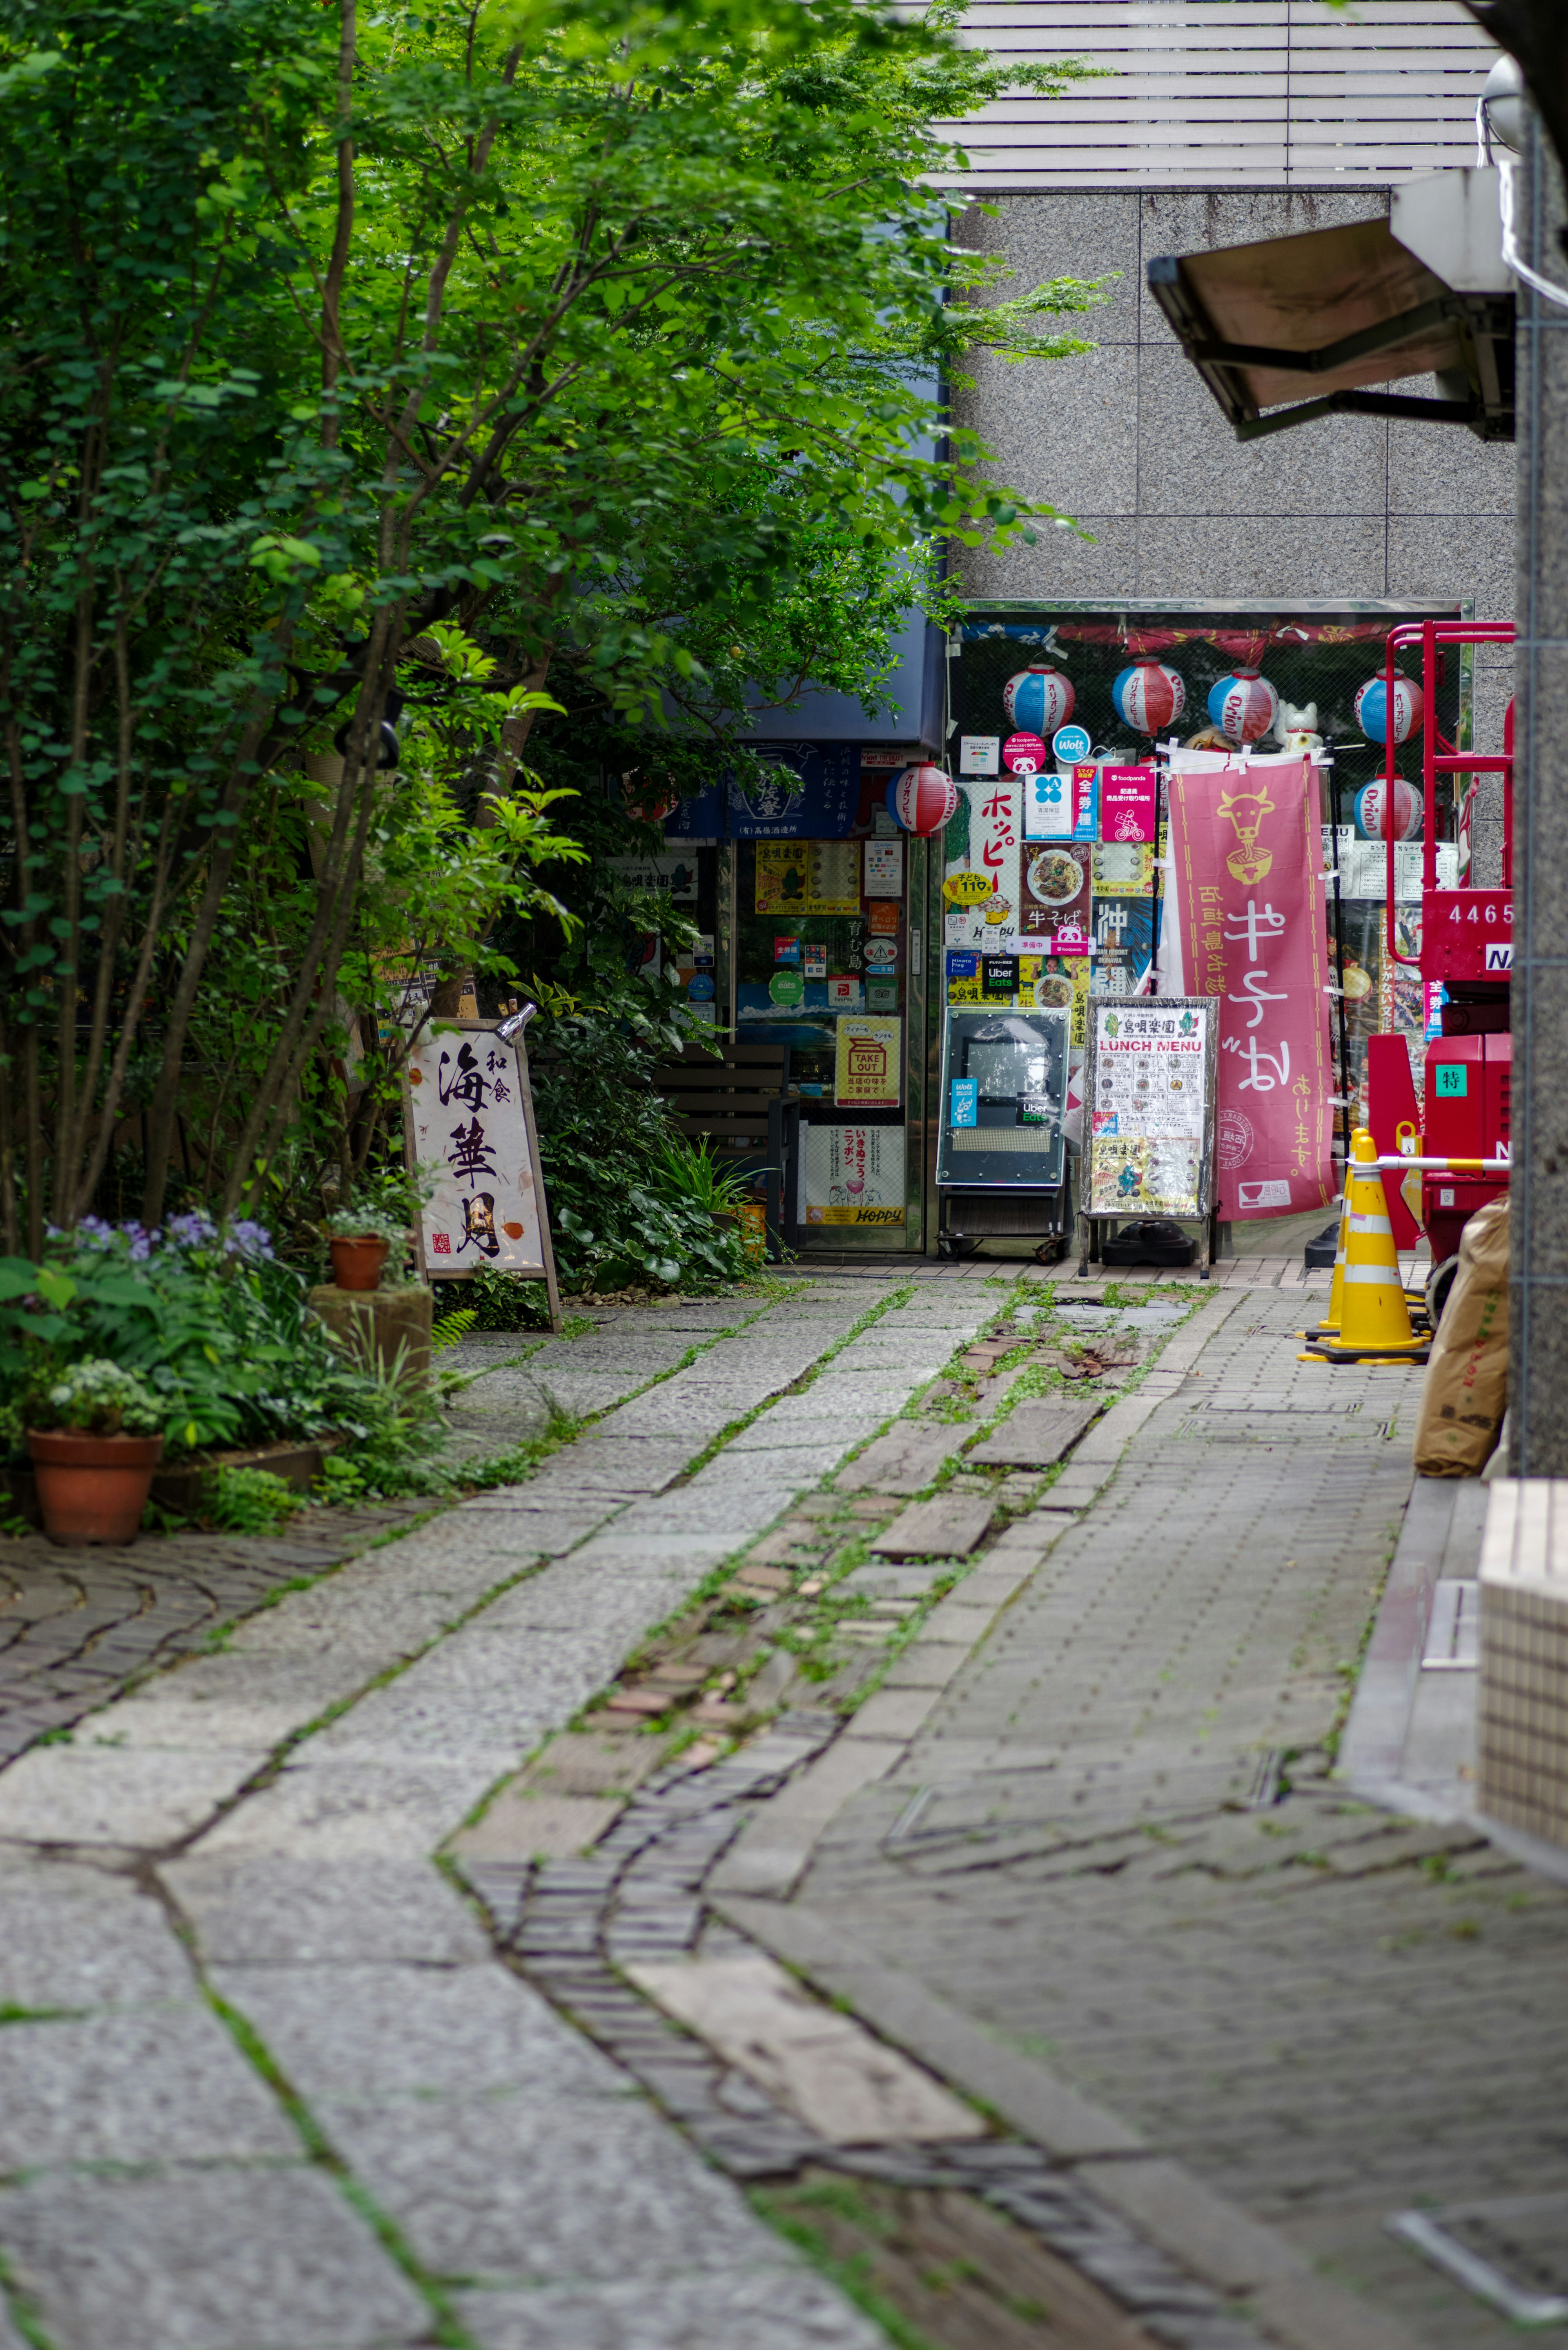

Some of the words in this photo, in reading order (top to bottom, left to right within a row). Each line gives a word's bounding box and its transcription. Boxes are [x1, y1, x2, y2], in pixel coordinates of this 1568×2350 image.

[1045, 684, 1057, 733] オリオンビール
[1129, 677, 1140, 726] オリオンビール
[1224, 696, 1243, 735] Orion
[1394, 693, 1403, 742] オリオンビール
[1059, 740, 1085, 750] Wolt
[902, 775, 914, 825] オリオンビール
[1078, 779, 1092, 826] 全券種
[1364, 789, 1379, 832] Orion
[762, 846, 803, 858] 島唄楽園
[981, 787, 1015, 893] ホッピー
[972, 926, 1015, 938] Hpy
[1028, 909, 1083, 928] 牛そば
[1097, 903, 1127, 947] 沖
[988, 968, 1013, 978] Uber
[989, 978, 1013, 987] Eats
[1074, 991, 1085, 1044] 島唄楽園
[1123, 1018, 1176, 1034] 島唄楽園
[1100, 1040, 1152, 1052] LUNCH
[1157, 1041, 1202, 1052] MENU
[486, 1050, 511, 1103] 和食
[1442, 1071, 1460, 1090] 特
[1022, 1113, 1047, 1121] Eats
[1023, 1104, 1047, 1113] Uber
[438, 1042, 501, 1259] 海華月
[844, 1130, 854, 1168] ニッポン。
[855, 1130, 865, 1181] いきぬこう、
[855, 1210, 902, 1222] Hoppy
